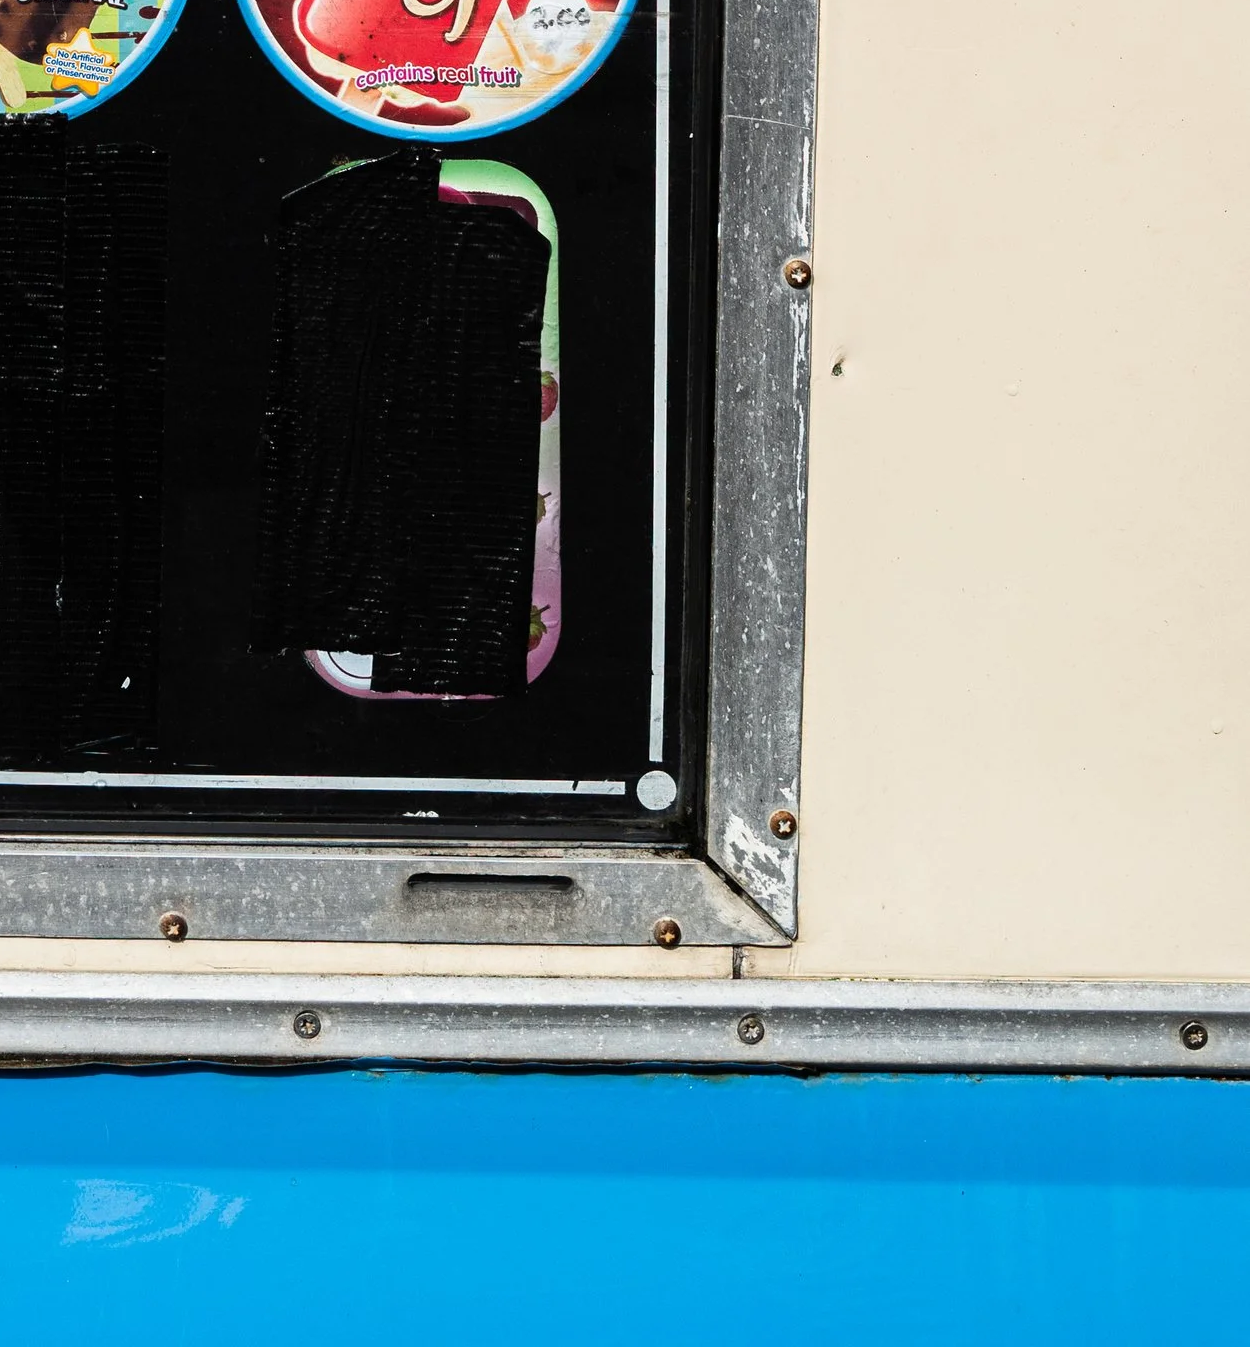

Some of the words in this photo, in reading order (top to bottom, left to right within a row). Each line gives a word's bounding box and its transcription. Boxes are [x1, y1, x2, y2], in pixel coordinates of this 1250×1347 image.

[45, 56, 78, 70] Colours,
[79, 62, 113, 75] Flavours
[57, 50, 70, 59] No
[71, 52, 104, 65] Artificial
[56, 67, 110, 83] Preservatives
[355, 61, 434, 91] contains
[437, 63, 476, 84] real
[478, 65, 519, 86] fruit
